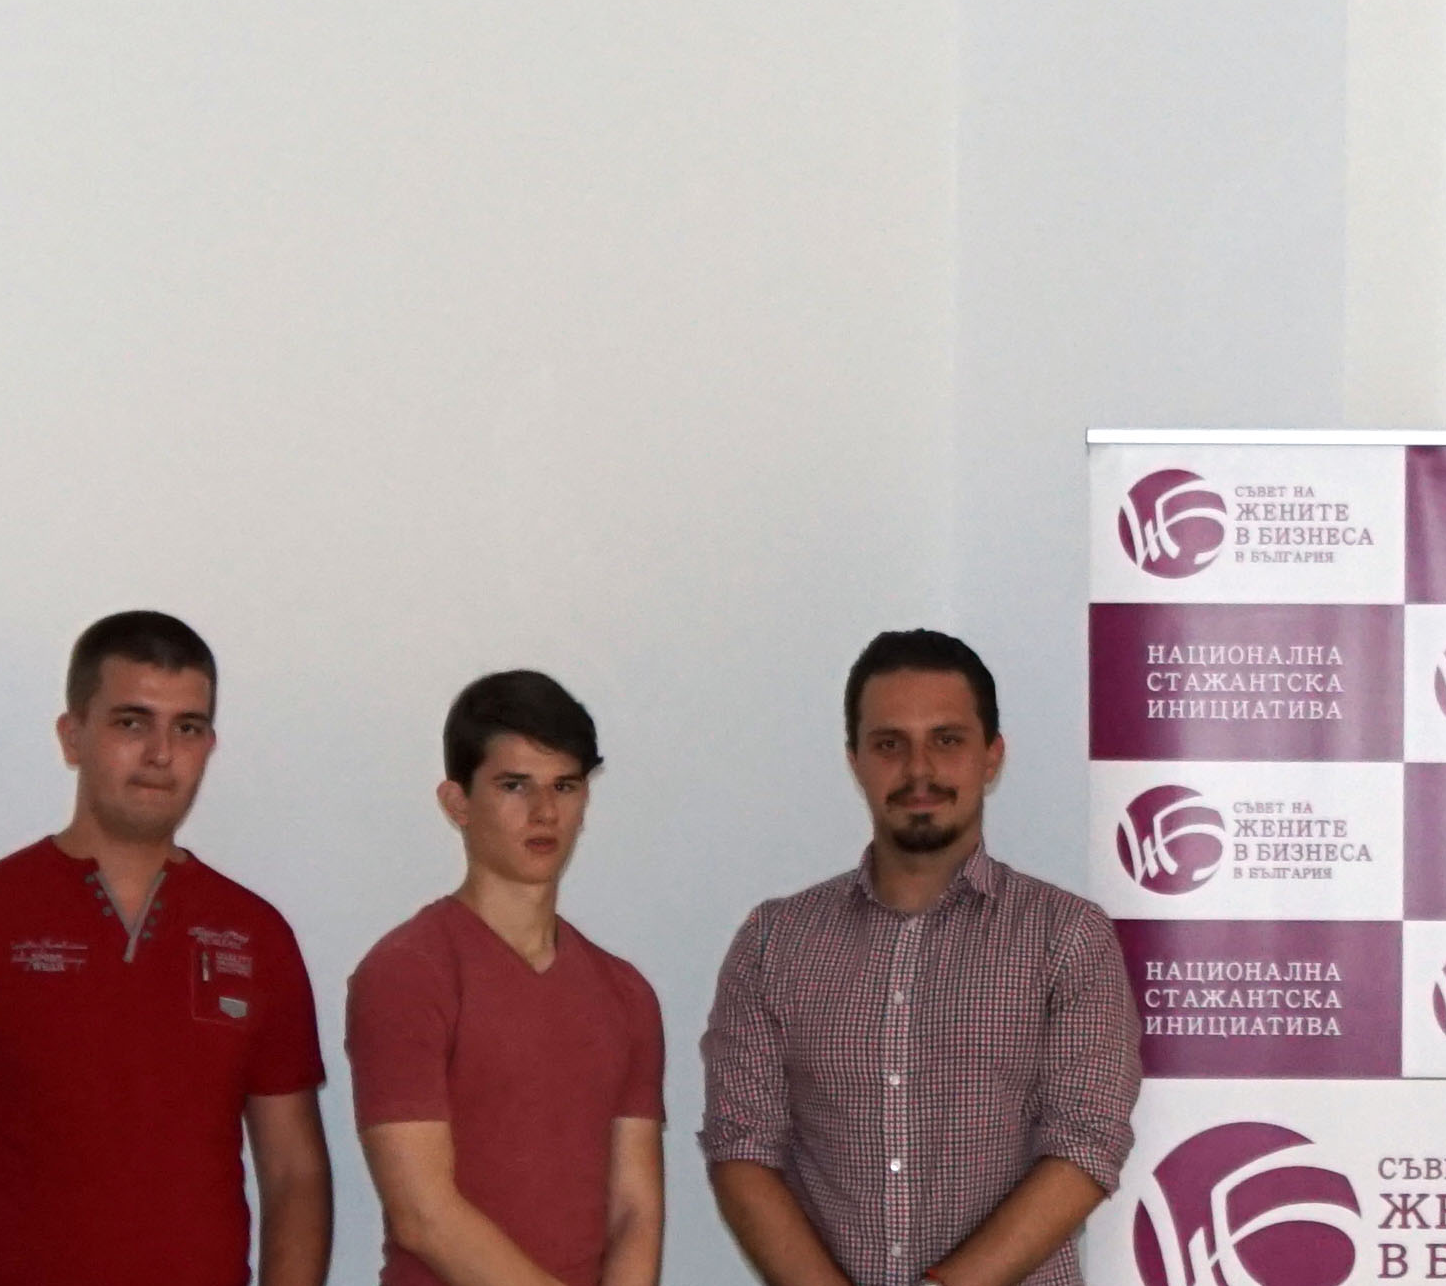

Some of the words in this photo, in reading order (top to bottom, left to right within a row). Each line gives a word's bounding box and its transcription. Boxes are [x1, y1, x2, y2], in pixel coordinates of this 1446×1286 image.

[1235, 486, 1287, 498] СЪВЕТ
[1294, 486, 1314, 497] НА
[1236, 503, 1349, 521] ЖЕНИТЕ
[1235, 527, 1250, 545] В
[1258, 527, 1374, 545] БИЗНЕСА
[1235, 551, 1245, 563] В
[1251, 551, 1333, 563] БЪЛГАРИЯ
[1147, 644, 1343, 666] НАЦИОНАЛНА
[1147, 672, 1343, 692] СТАЖАНТСКА
[1147, 700, 1342, 720] ИНИЦИАТИВА
[1233, 802, 1285, 814] СЪВЕТ
[1292, 802, 1313, 813] НА
[1234, 819, 1347, 837] ЖЕНИТЕ
[1234, 844, 1248, 861] В
[1257, 843, 1372, 861] БИЗНЕСА
[1234, 867, 1243, 879] В
[1249, 867, 1332, 879] БЪЛГАРИЯ
[1146, 962, 1341, 983] НАЦИОНАЛНА
[1145, 989, 1342, 1008] СТАЖАНТСКА
[1146, 1016, 1341, 1037] ИНИЦИАТИВА
[1378, 1243, 1408, 1278] В
